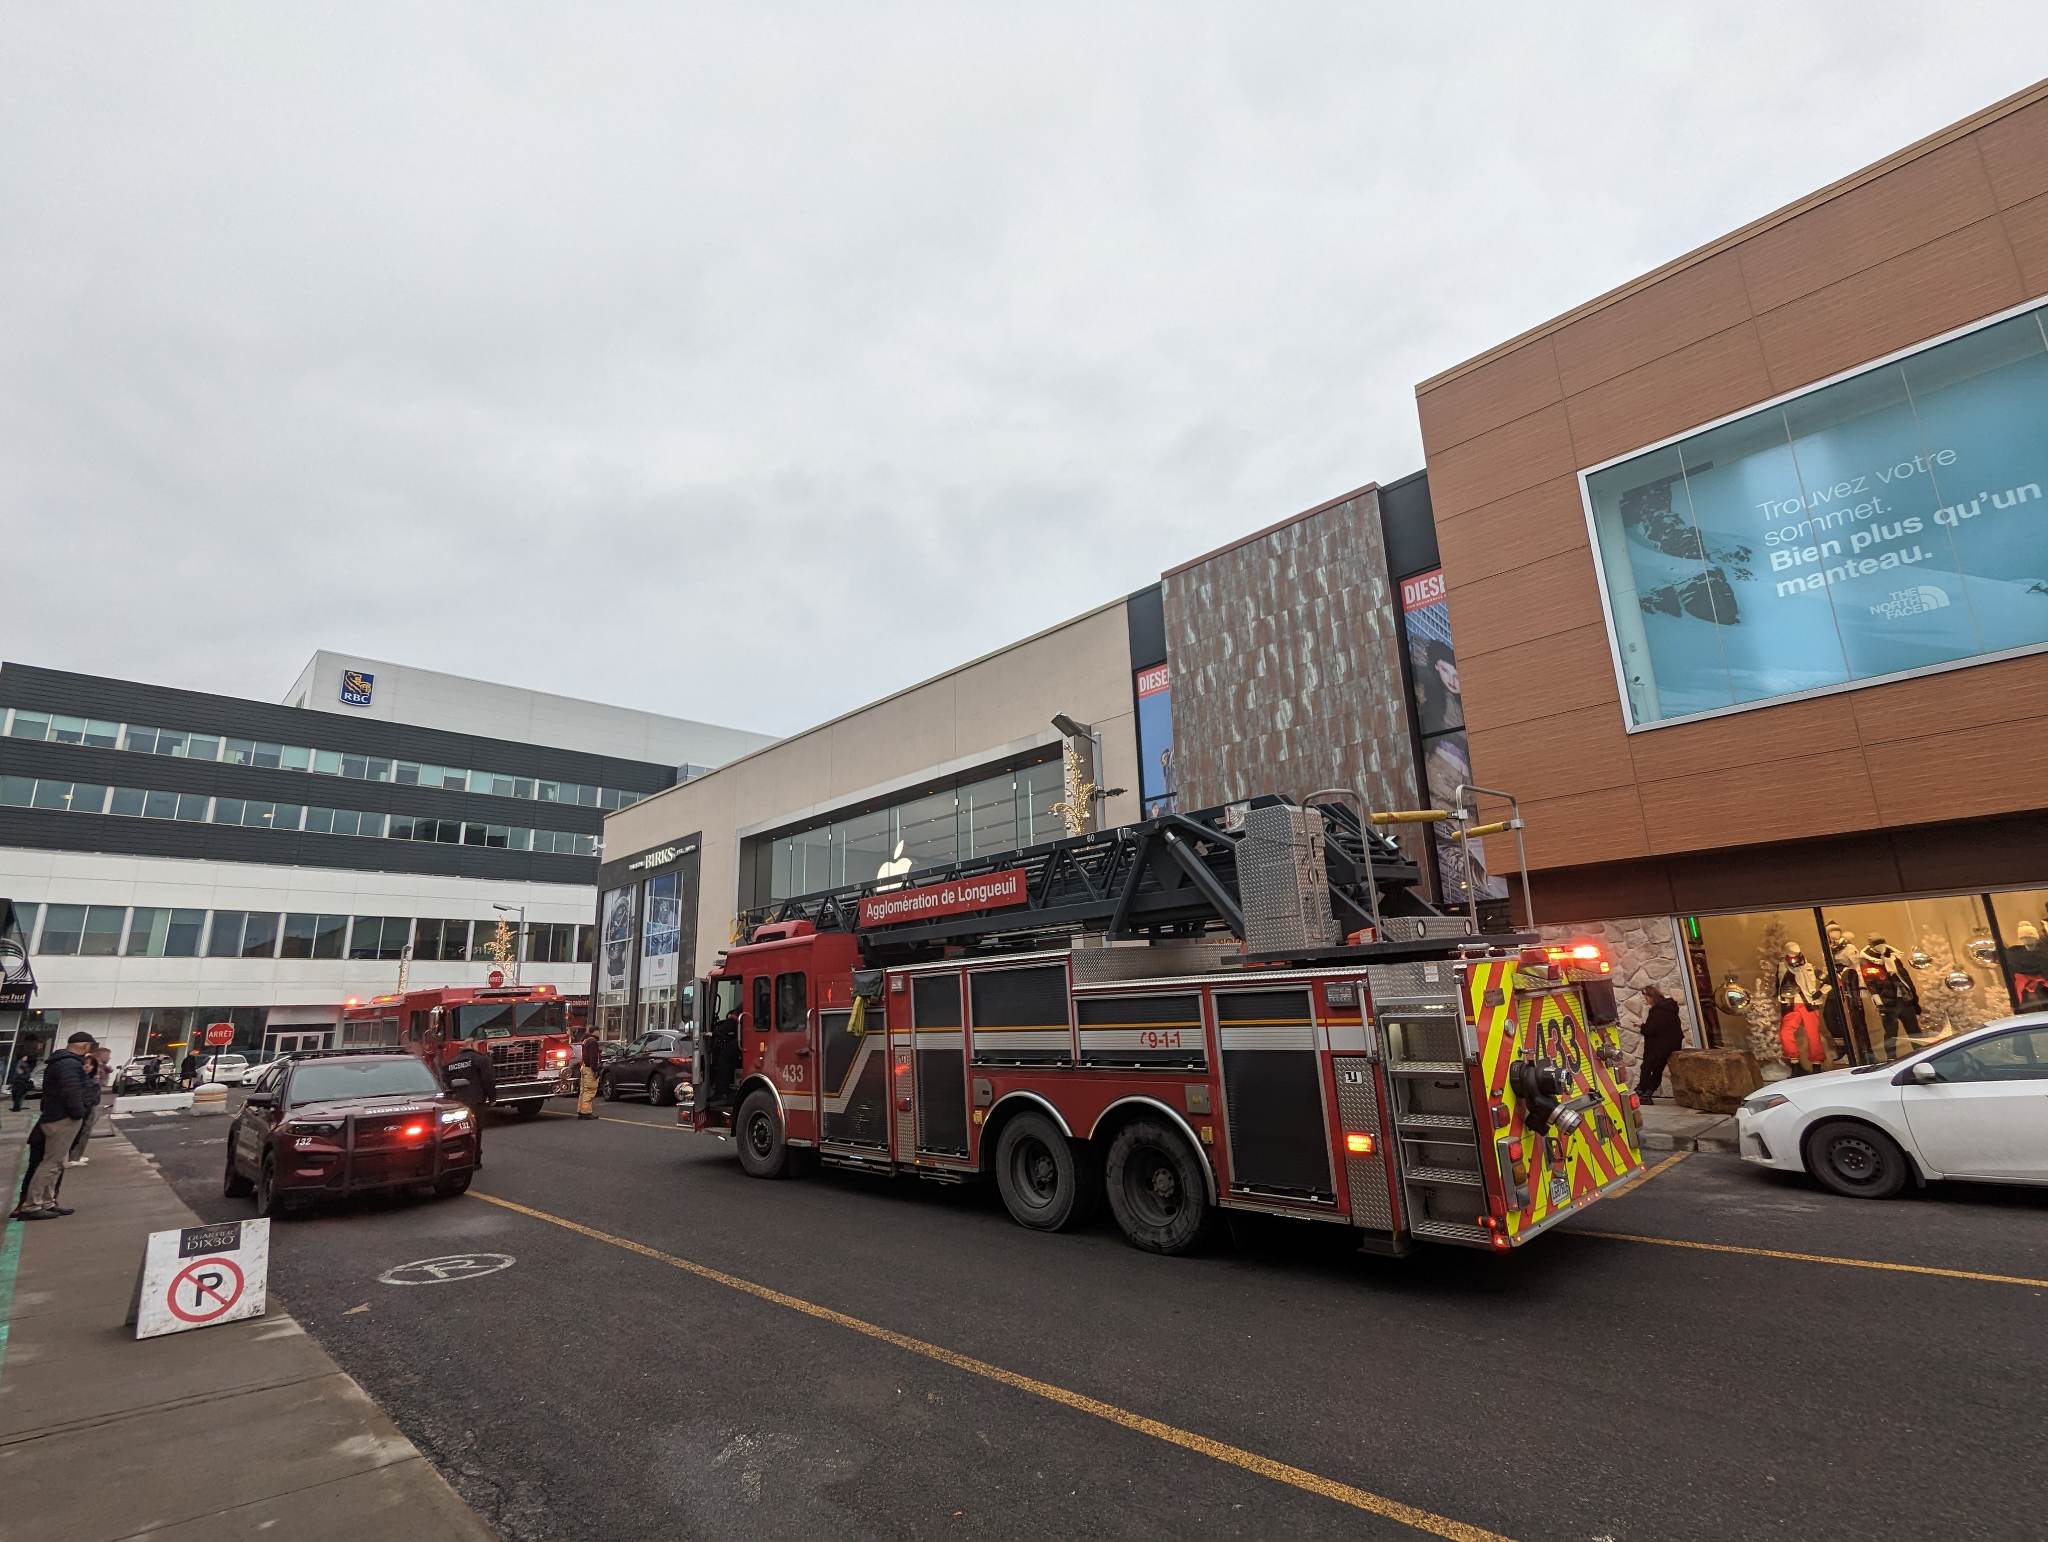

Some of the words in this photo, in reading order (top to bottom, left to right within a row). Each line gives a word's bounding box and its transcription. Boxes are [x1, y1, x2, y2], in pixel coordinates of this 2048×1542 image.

[1755, 475, 1869, 521] Trouvez
[1876, 449, 1957, 484] votre
[1764, 496, 1892, 547] sommet.
[1769, 539, 1841, 572] Bien
[1850, 516, 1924, 553] plus
[1933, 483, 2042, 527] qu'un
[1776, 544, 1933, 598] manteau.
[1889, 587, 1918, 600] THE
[1870, 595, 1921, 615] NORTH
[1886, 604, 1923, 620] FACE
[1139, 669, 1169, 692] DIESE
[344, 692, 369, 703] RBC
[1086, 833, 1095, 843] 60
[645, 847, 676, 869] BIRKS
[866, 893, 939, 920] Agglomération
[941, 889, 955, 903] de
[958, 877, 1017, 902] Longueuil
[208, 1030, 233, 1038] ARRÊT
[1534, 1015, 1581, 1074] 433
[782, 1064, 804, 1082] 433
[295, 1137, 312, 1147] 132
[187, 1229, 235, 1241] QUARTIER
[195, 1272, 224, 1307] P
